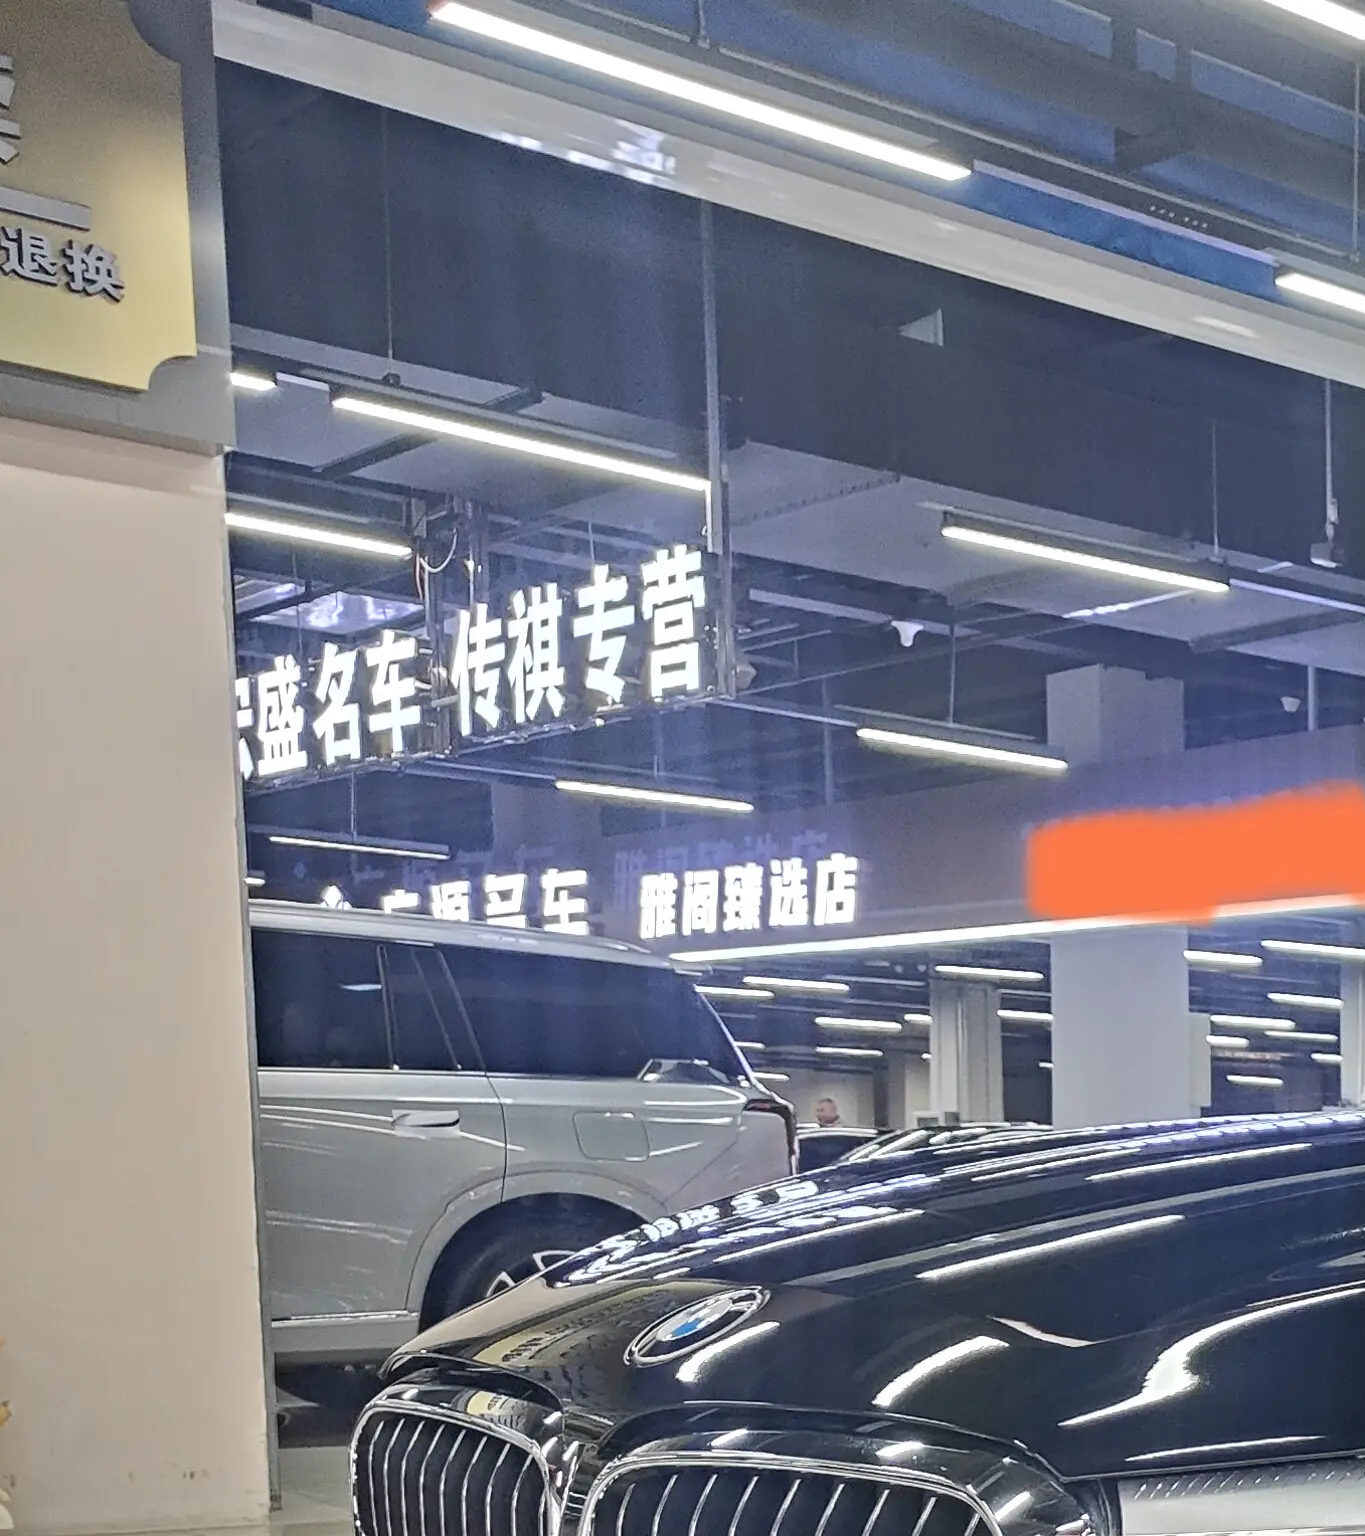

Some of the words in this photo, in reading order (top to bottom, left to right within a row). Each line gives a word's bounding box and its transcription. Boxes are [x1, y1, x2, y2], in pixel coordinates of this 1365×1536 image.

[449, 544, 706, 737] 传祺专营
[640, 852, 859, 940] 雅阁臻选店
